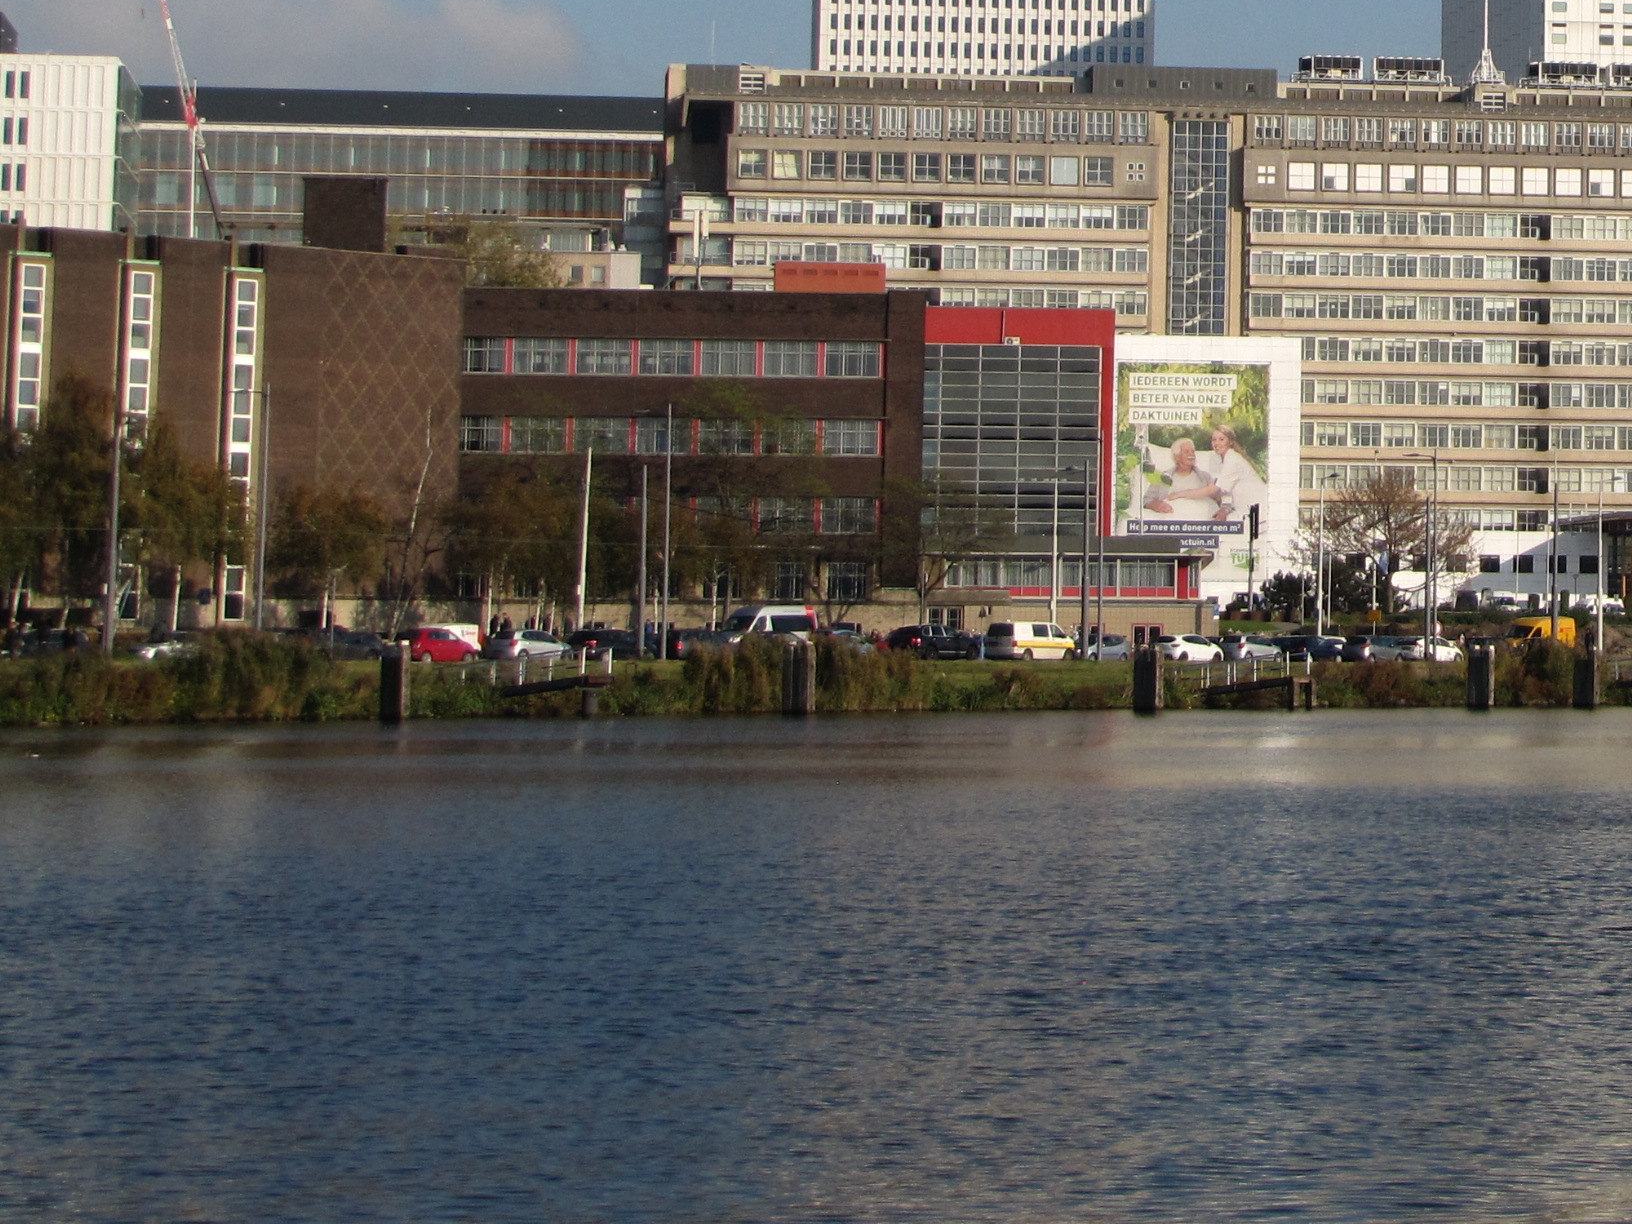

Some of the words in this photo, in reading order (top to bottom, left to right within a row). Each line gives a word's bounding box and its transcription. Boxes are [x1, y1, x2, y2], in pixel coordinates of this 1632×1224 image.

[1133, 376, 1189, 386] IEDEREEN
[1192, 377, 1233, 387] WORDT
[1133, 393, 1169, 403] BETER
[1172, 394, 1194, 403] VAN
[1198, 394, 1227, 404] ONZE
[1133, 411, 1198, 421] DAKTUINEN
[1129, 522, 1149, 533] Hep
[1182, 523, 1211, 531] doneer
